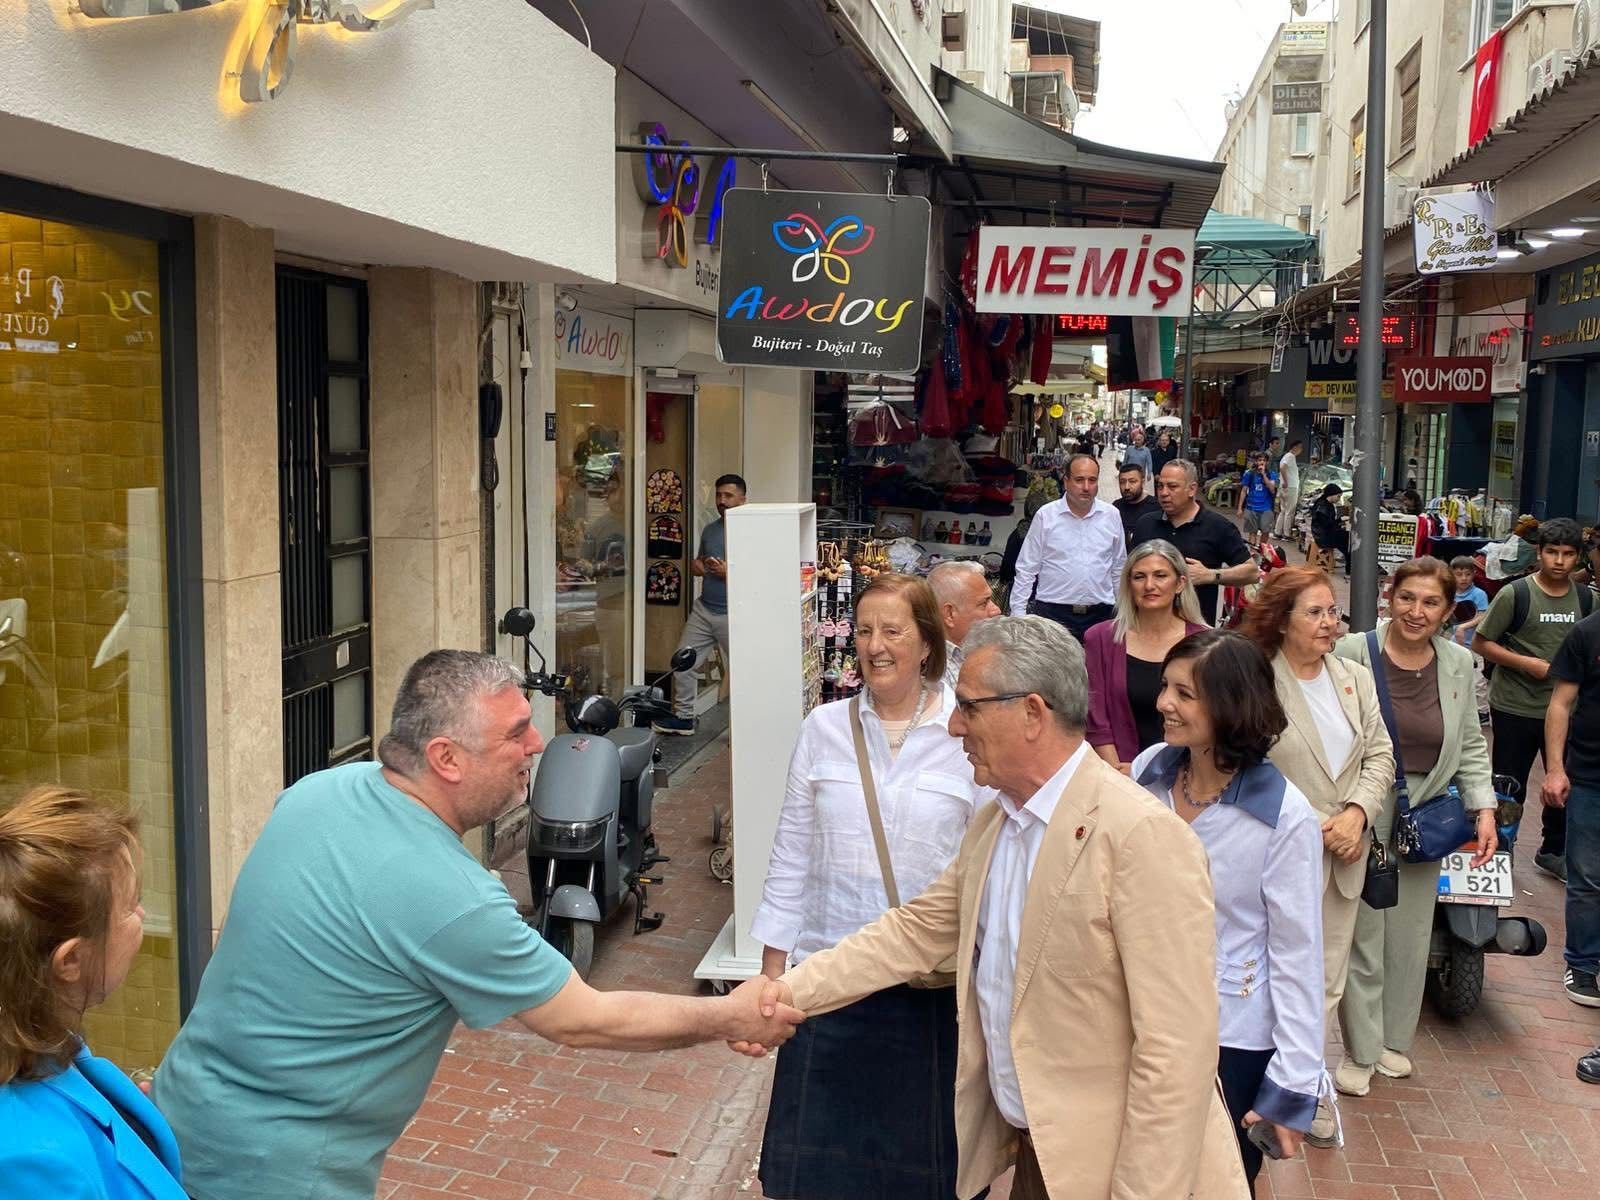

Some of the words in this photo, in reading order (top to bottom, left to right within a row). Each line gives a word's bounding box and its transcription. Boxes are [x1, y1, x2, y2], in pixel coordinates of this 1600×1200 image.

[985, 234, 1185, 309] MEMİŞ
[725, 285, 915, 333] Awdoy
[752, 336, 802, 353] Bujiteri
[815, 339, 857, 357] Doğal
[860, 342, 884, 358] Taş
[1401, 368, 1487, 391] YOUMOOD
[1539, 611, 1575, 623] mavi
[1466, 876, 1500, 893] 521
